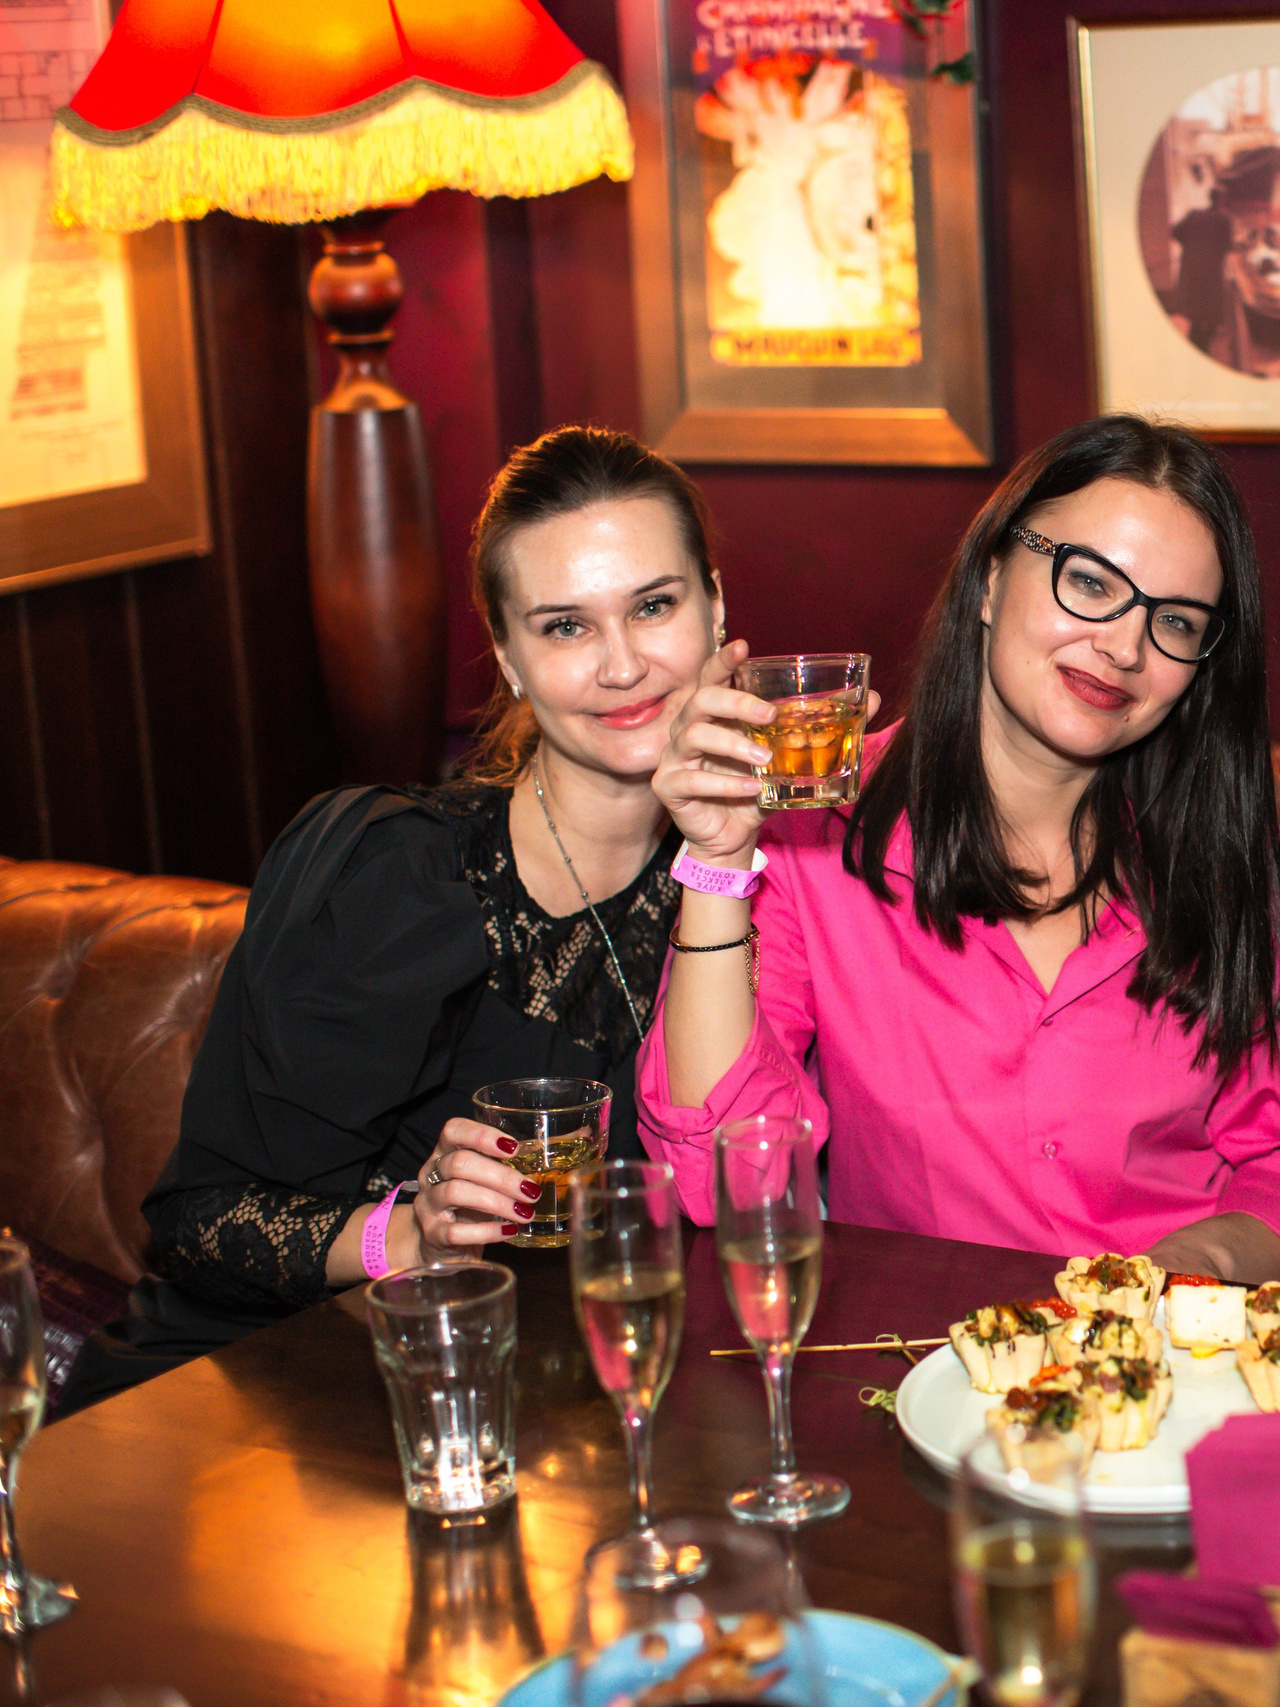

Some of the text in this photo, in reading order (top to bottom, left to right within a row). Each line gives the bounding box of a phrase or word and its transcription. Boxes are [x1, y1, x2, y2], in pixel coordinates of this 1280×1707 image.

[690, 870, 734, 886] АЛЕКСЕЯ
[692, 863, 737, 879] КОЗЛОВА
[696, 881, 723, 892] КЛУБ
